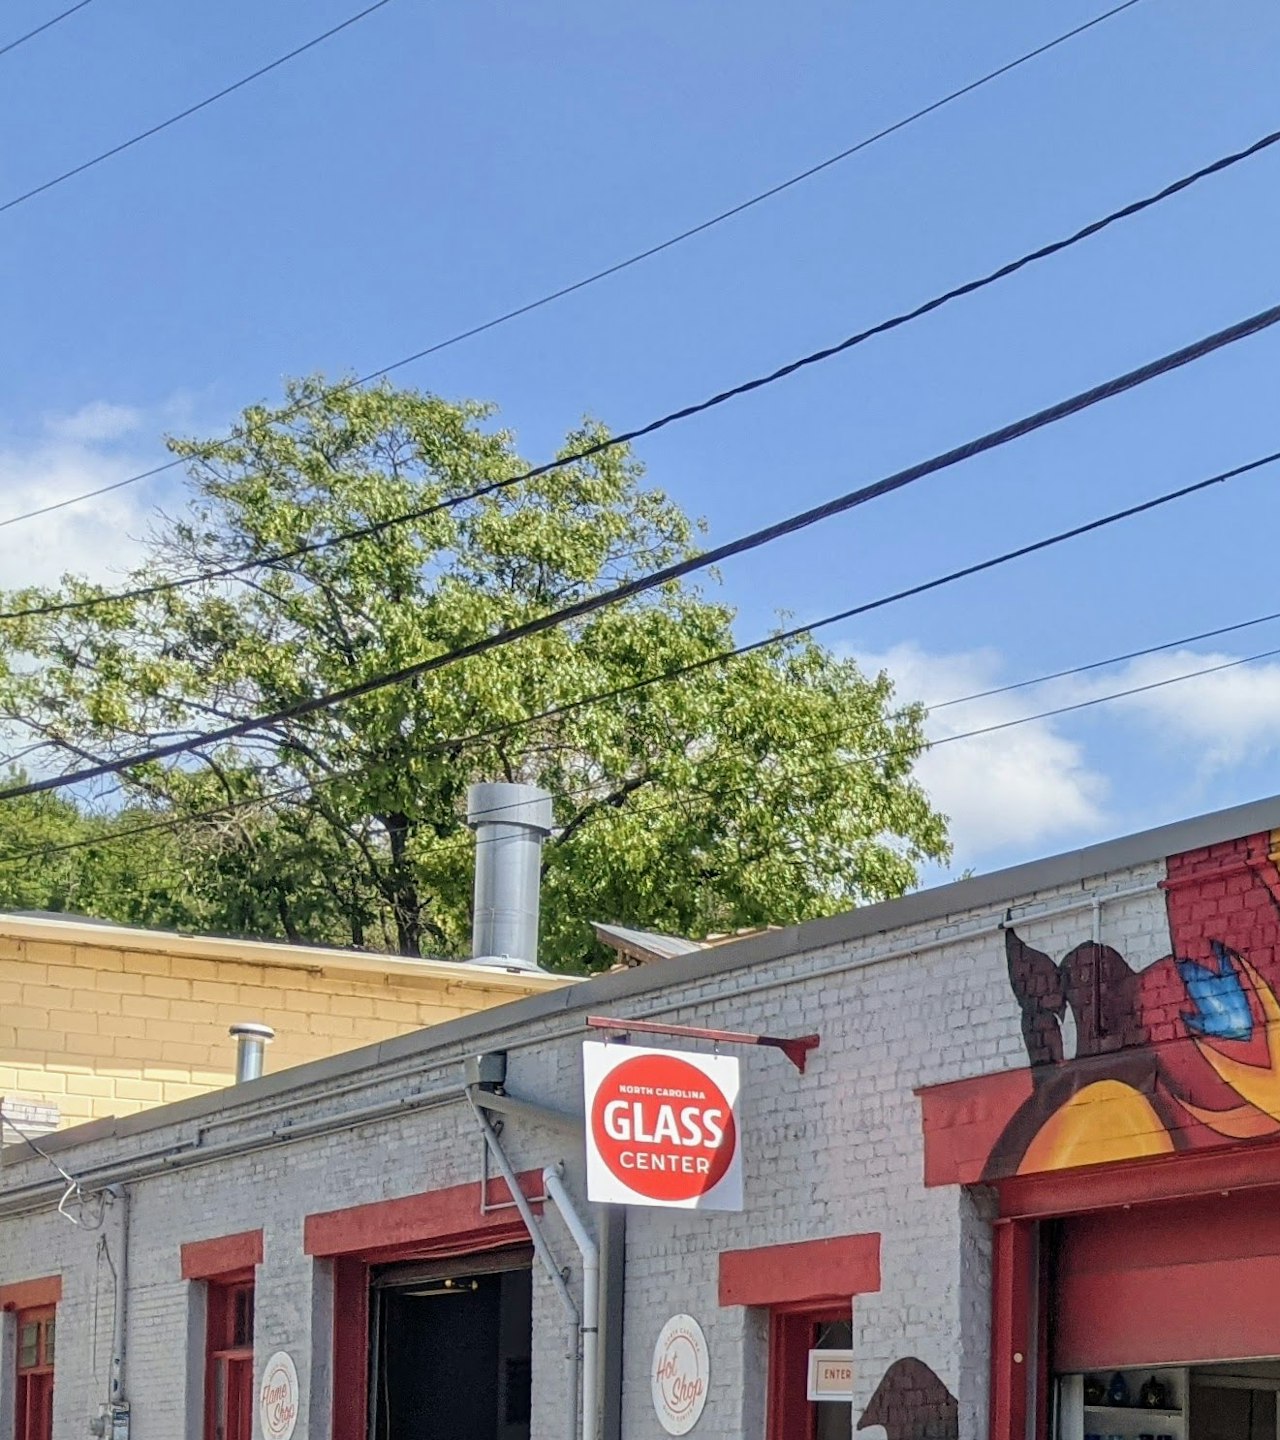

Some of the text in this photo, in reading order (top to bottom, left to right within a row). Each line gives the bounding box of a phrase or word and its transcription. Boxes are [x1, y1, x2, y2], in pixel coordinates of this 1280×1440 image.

[619, 1084, 706, 1099] NORTH CAROLINA
[603, 1099, 722, 1149] GLASS
[619, 1151, 710, 1174] CENTER
[656, 1350, 678, 1383] Hot
[824, 1368, 852, 1380] ENTER
[671, 1375, 703, 1407] Shop
[273, 1401, 295, 1426] Shop
